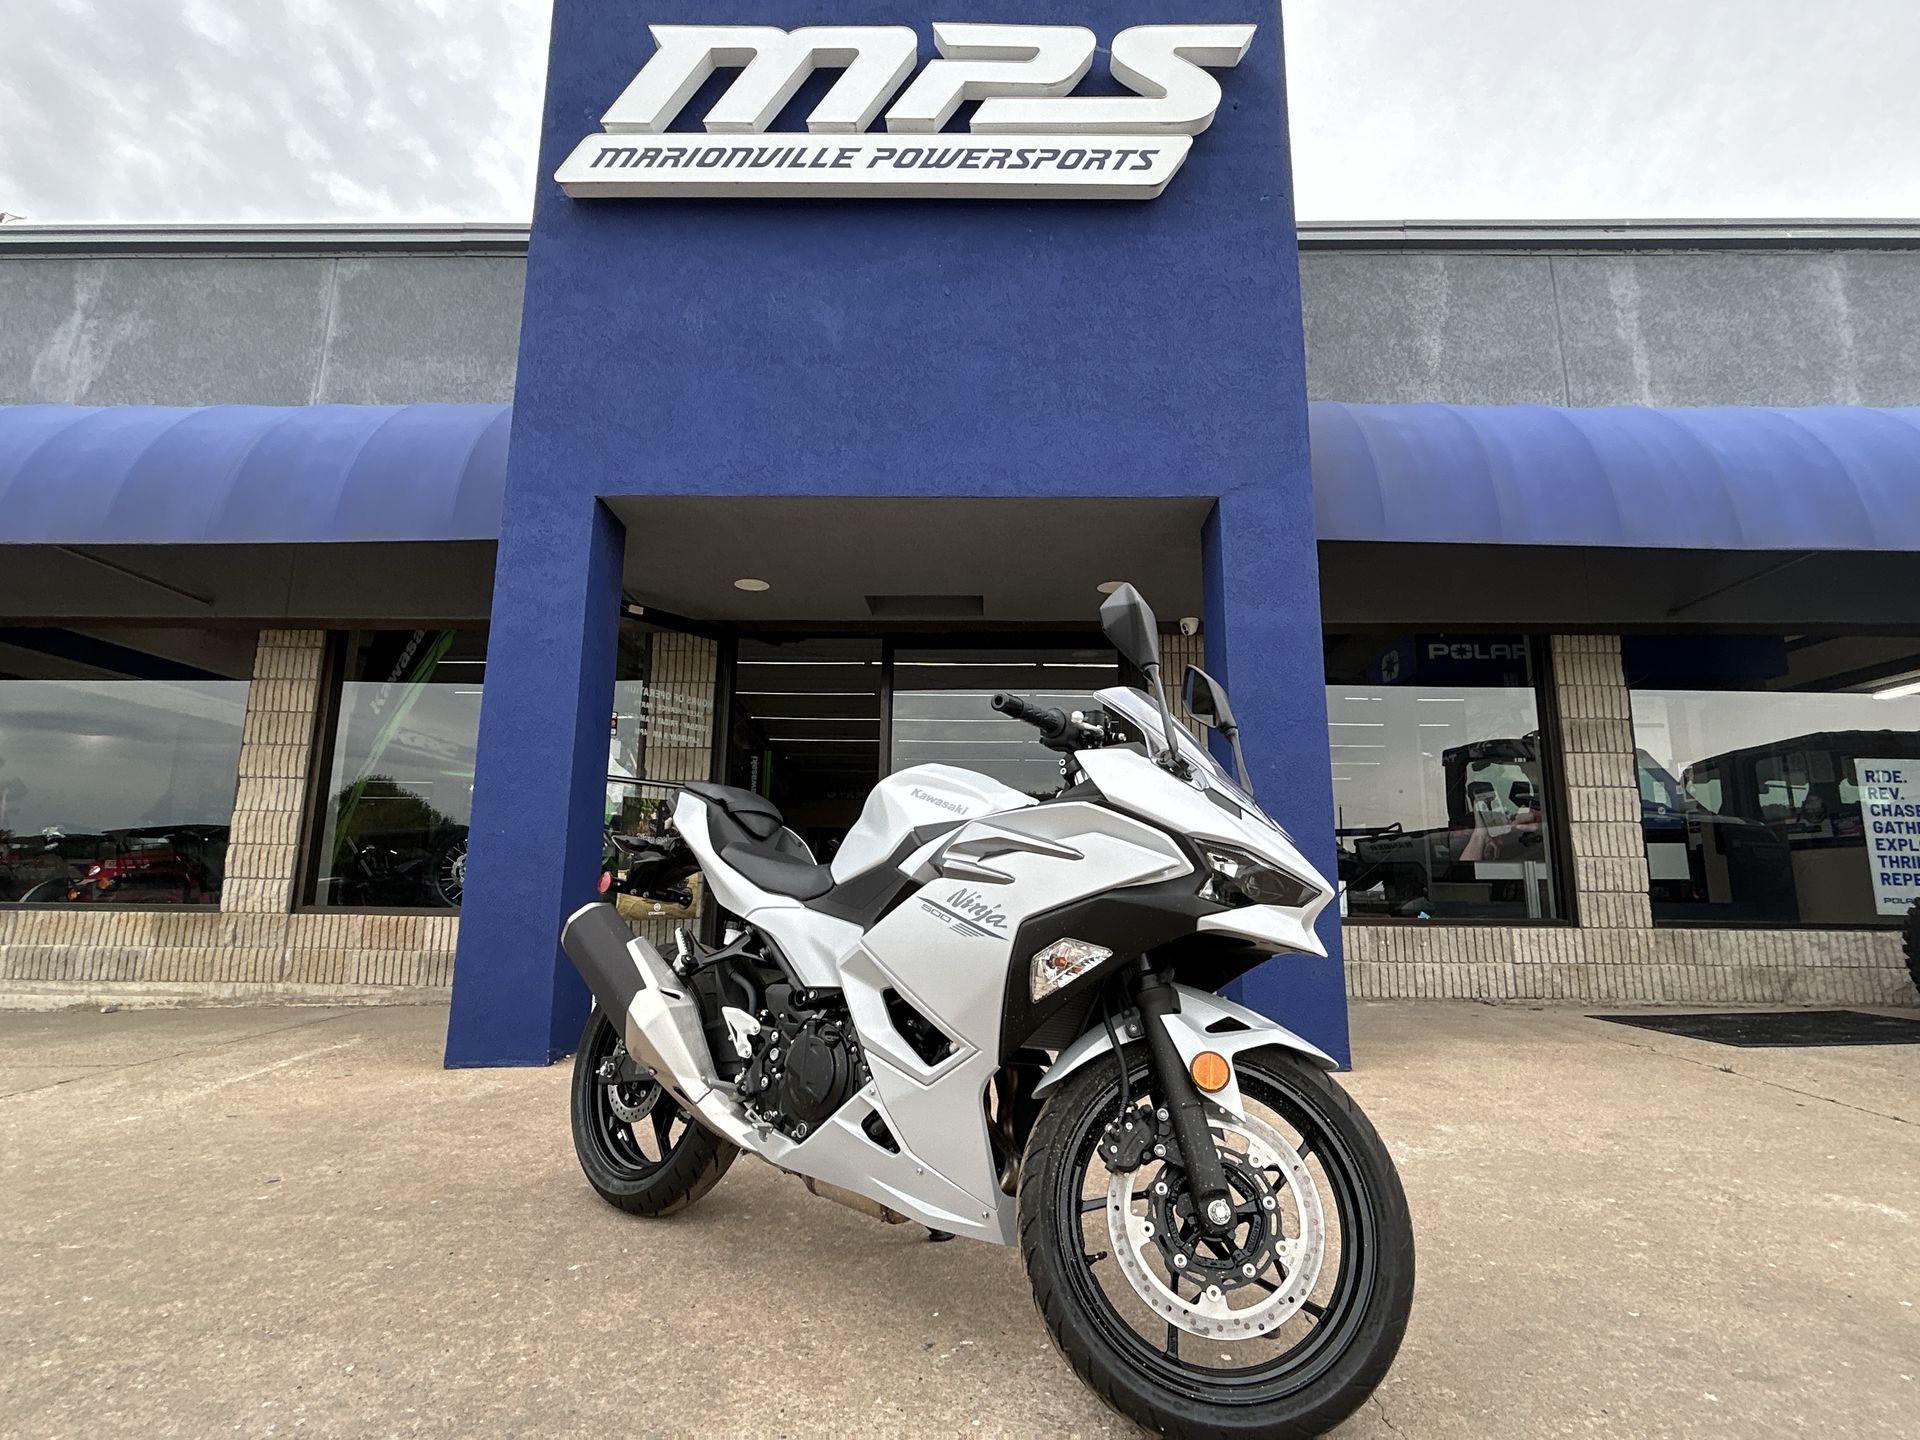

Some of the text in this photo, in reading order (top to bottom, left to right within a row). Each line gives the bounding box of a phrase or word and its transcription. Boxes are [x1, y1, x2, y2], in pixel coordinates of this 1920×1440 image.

[600, 22, 1258, 133] MPS
[589, 146, 1161, 171] MARIONVILLE POWERSPORTS
[369, 629, 426, 715] Kawasa
[1865, 770, 1908, 783] RIDE.
[910, 787, 969, 816] Kawasaki
[1867, 787, 1905, 800] REV.
[1875, 838, 1920, 851] EXPL
[946, 888, 1008, 929] Ninja
[1884, 897, 1914, 905] POLA
[920, 903, 952, 924] 500
